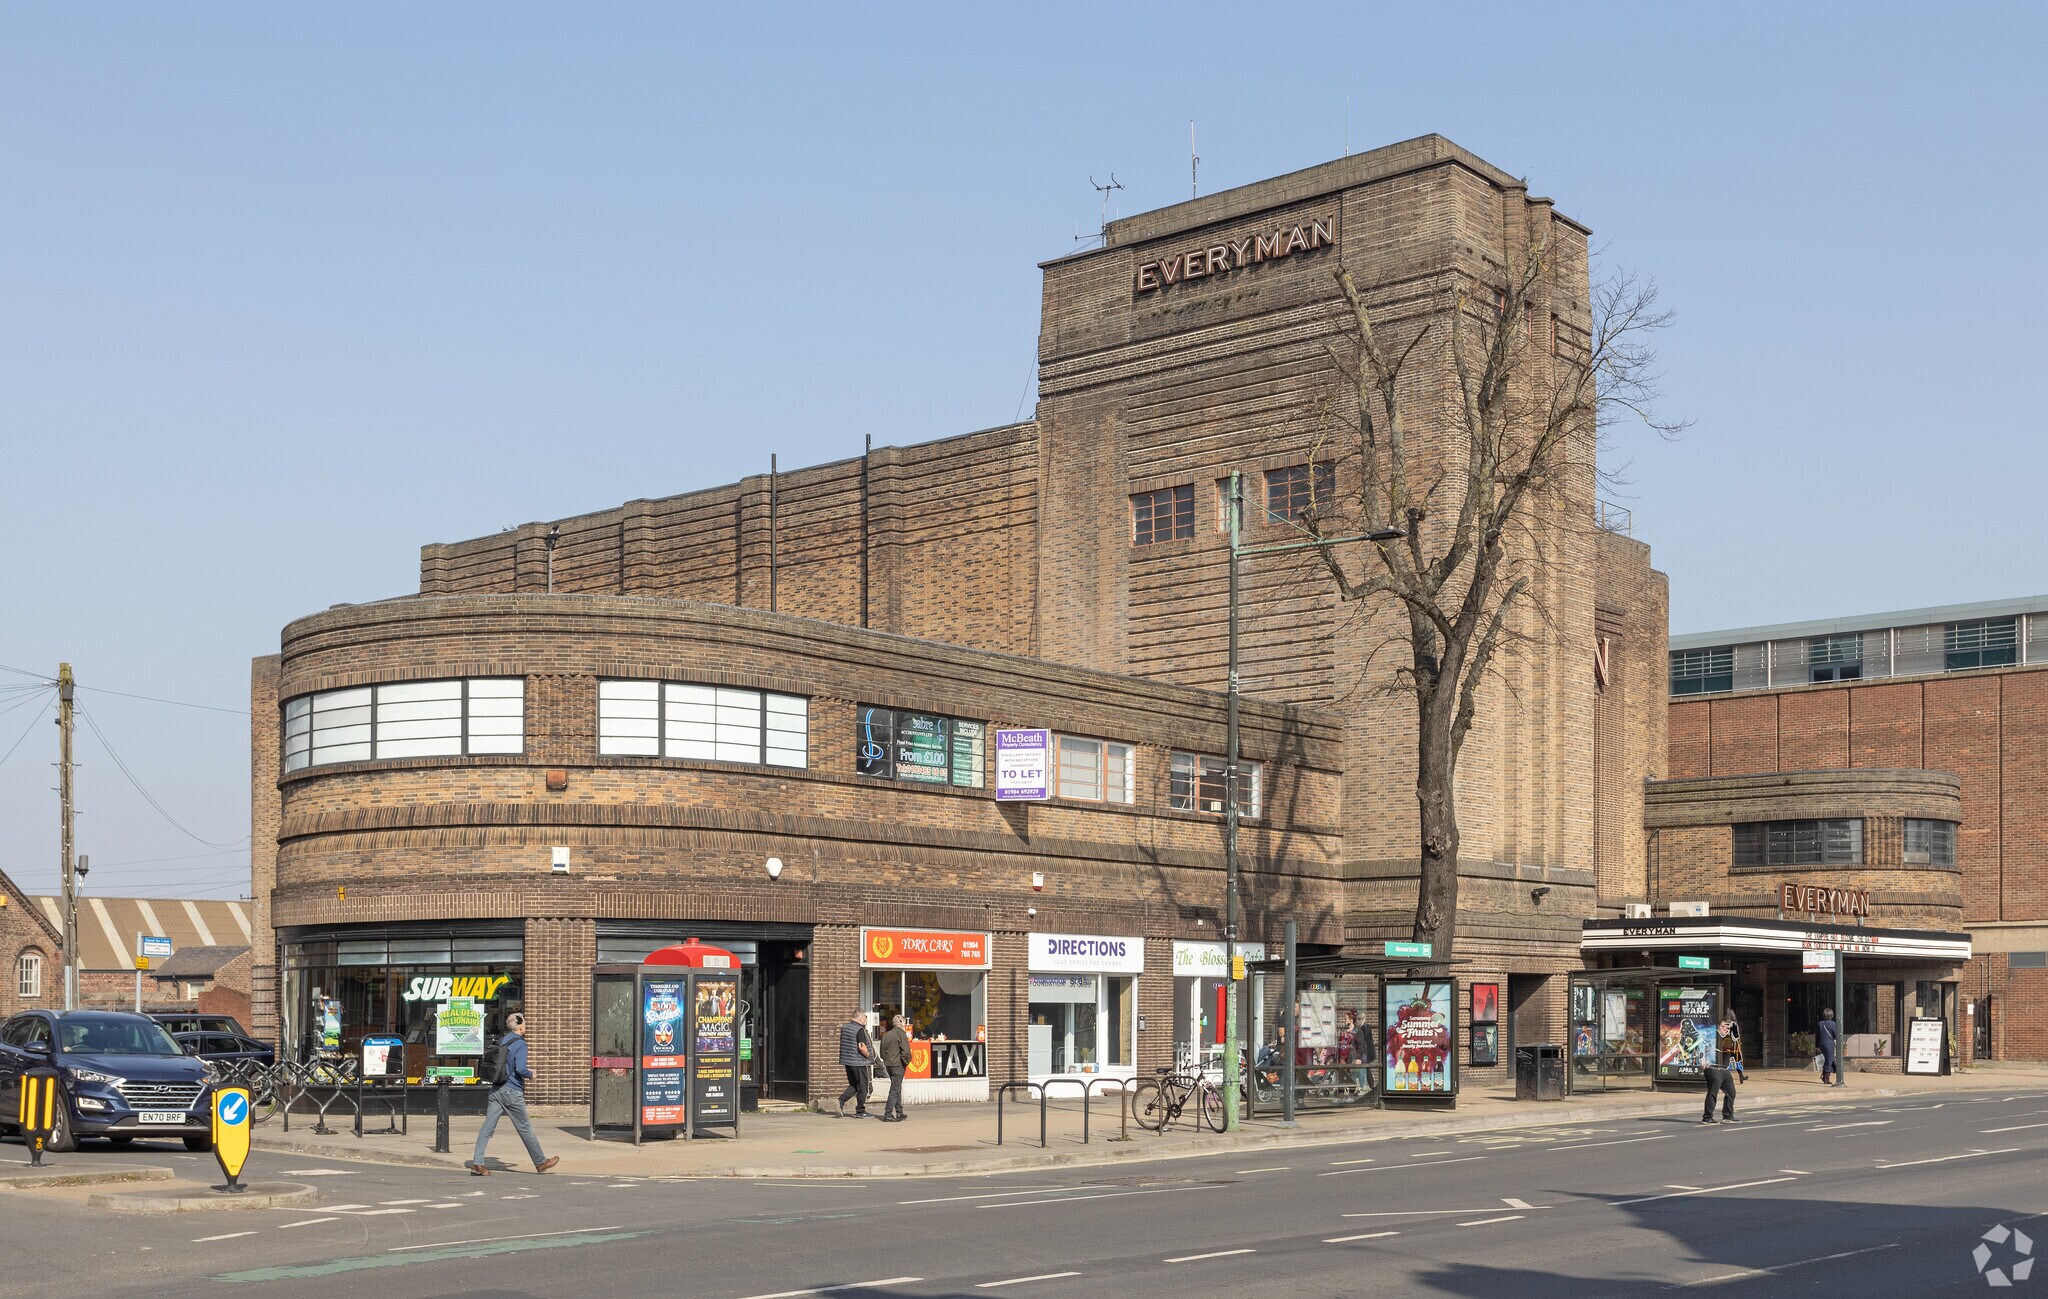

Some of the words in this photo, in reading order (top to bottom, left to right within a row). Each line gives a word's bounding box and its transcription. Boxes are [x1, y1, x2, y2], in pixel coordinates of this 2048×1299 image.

[1138, 213, 1336, 292] EVERYMAN
[958, 721, 979, 730] SERVICES
[1002, 733, 1042, 743] McBeath
[900, 748, 922, 763] From
[1001, 770, 1017, 778] TO
[1021, 769, 1042, 778] LET
[1781, 882, 1869, 917] EVERYMAN
[1624, 927, 1676, 936] EVERYMAN
[901, 938, 929, 953] YORK
[929, 939, 953, 953] CARS
[963, 941, 978, 949] 01904
[1048, 939, 1126, 957] DIRECTIONS
[961, 950, 971, 958] 765
[1175, 949, 1194, 965] The
[403, 974, 510, 1002] SUBWAY
[439, 1009, 460, 1019] MEAL
[461, 1009, 481, 1019] DEAL
[1682, 1006, 1710, 1014] WARS
[701, 1023, 730, 1032] MAGIC
[1401, 1020, 1440, 1029] Summer
[1406, 1028, 1434, 1038] Fruits
[932, 1044, 983, 1076] TAXI
[142, 1113, 164, 1122] EN70
[166, 1113, 182, 1122] BRF
